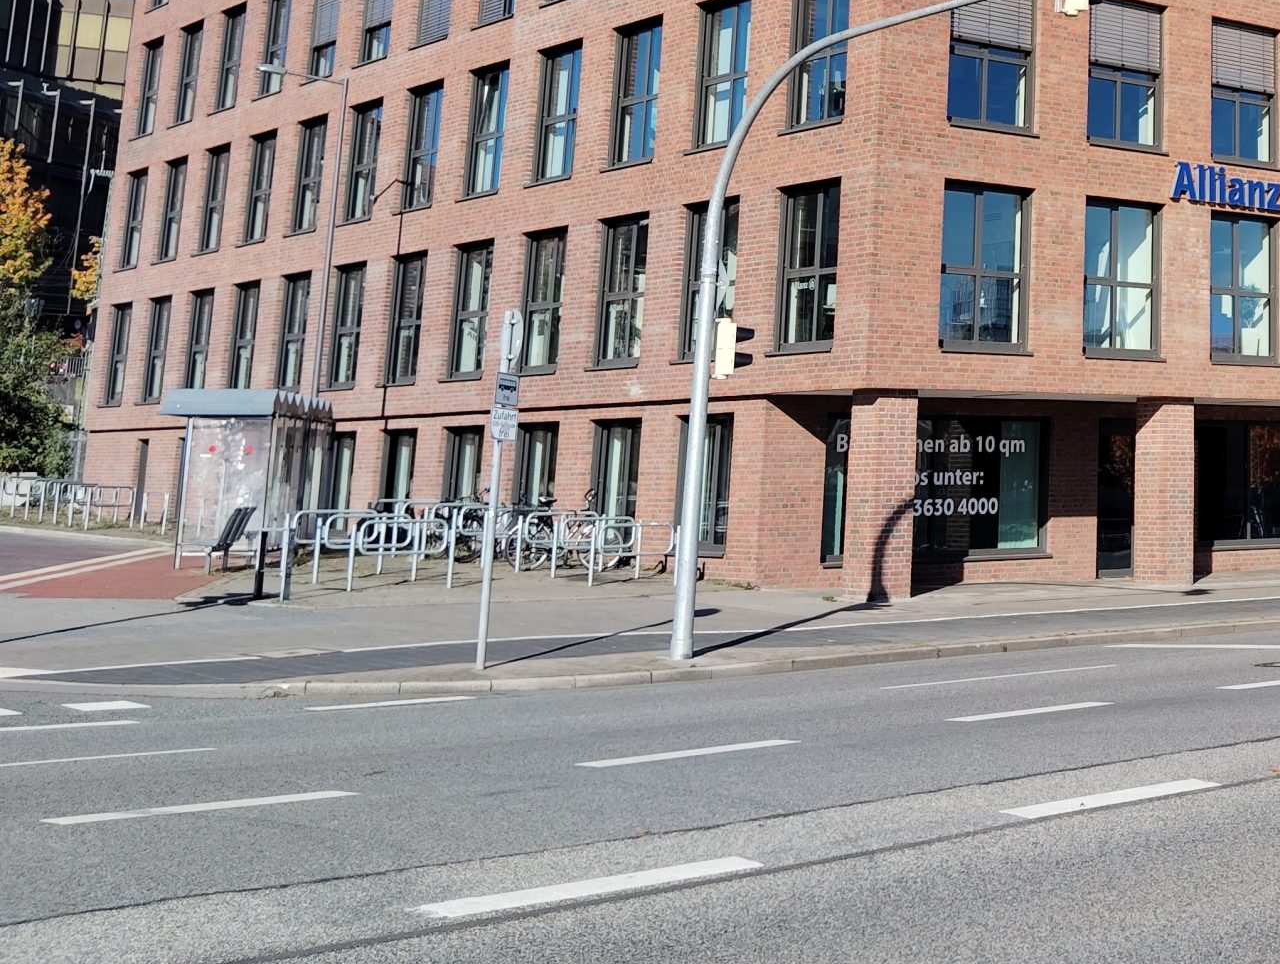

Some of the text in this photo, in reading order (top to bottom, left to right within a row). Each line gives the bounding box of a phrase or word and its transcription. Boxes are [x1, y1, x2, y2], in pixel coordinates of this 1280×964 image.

[493, 409, 516, 421] Zufahrt
[949, 434, 971, 453] ab
[977, 435, 996, 453] 10
[999, 439, 1026, 458] qm
[933, 470, 985, 486] unter:
[957, 497, 999, 515] 4000
